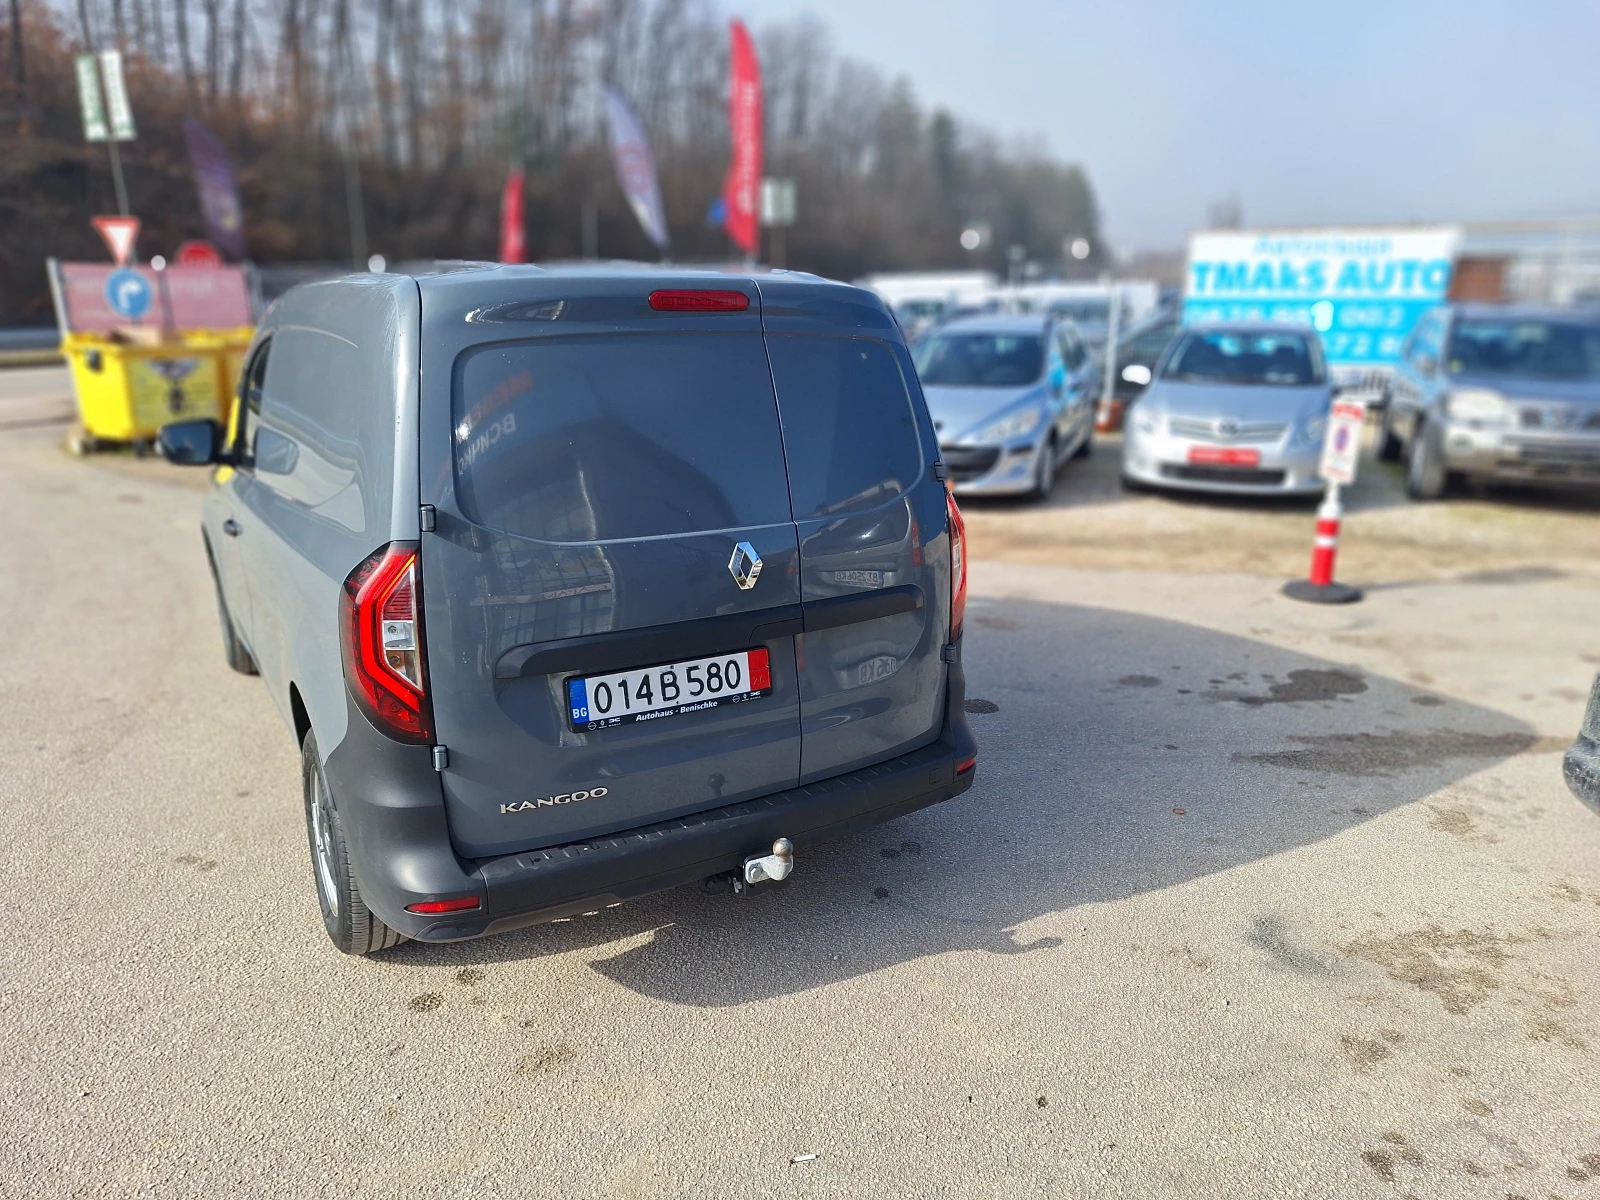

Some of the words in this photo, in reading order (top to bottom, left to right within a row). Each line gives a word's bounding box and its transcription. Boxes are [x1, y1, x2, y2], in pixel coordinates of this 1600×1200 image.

[1335, 259, 1453, 291] AUTO
[572, 707, 588, 719] BG
[635, 709, 674, 722] Autohaus
[680, 699, 718, 715] Benischke
[500, 787, 608, 814] KANGOO
